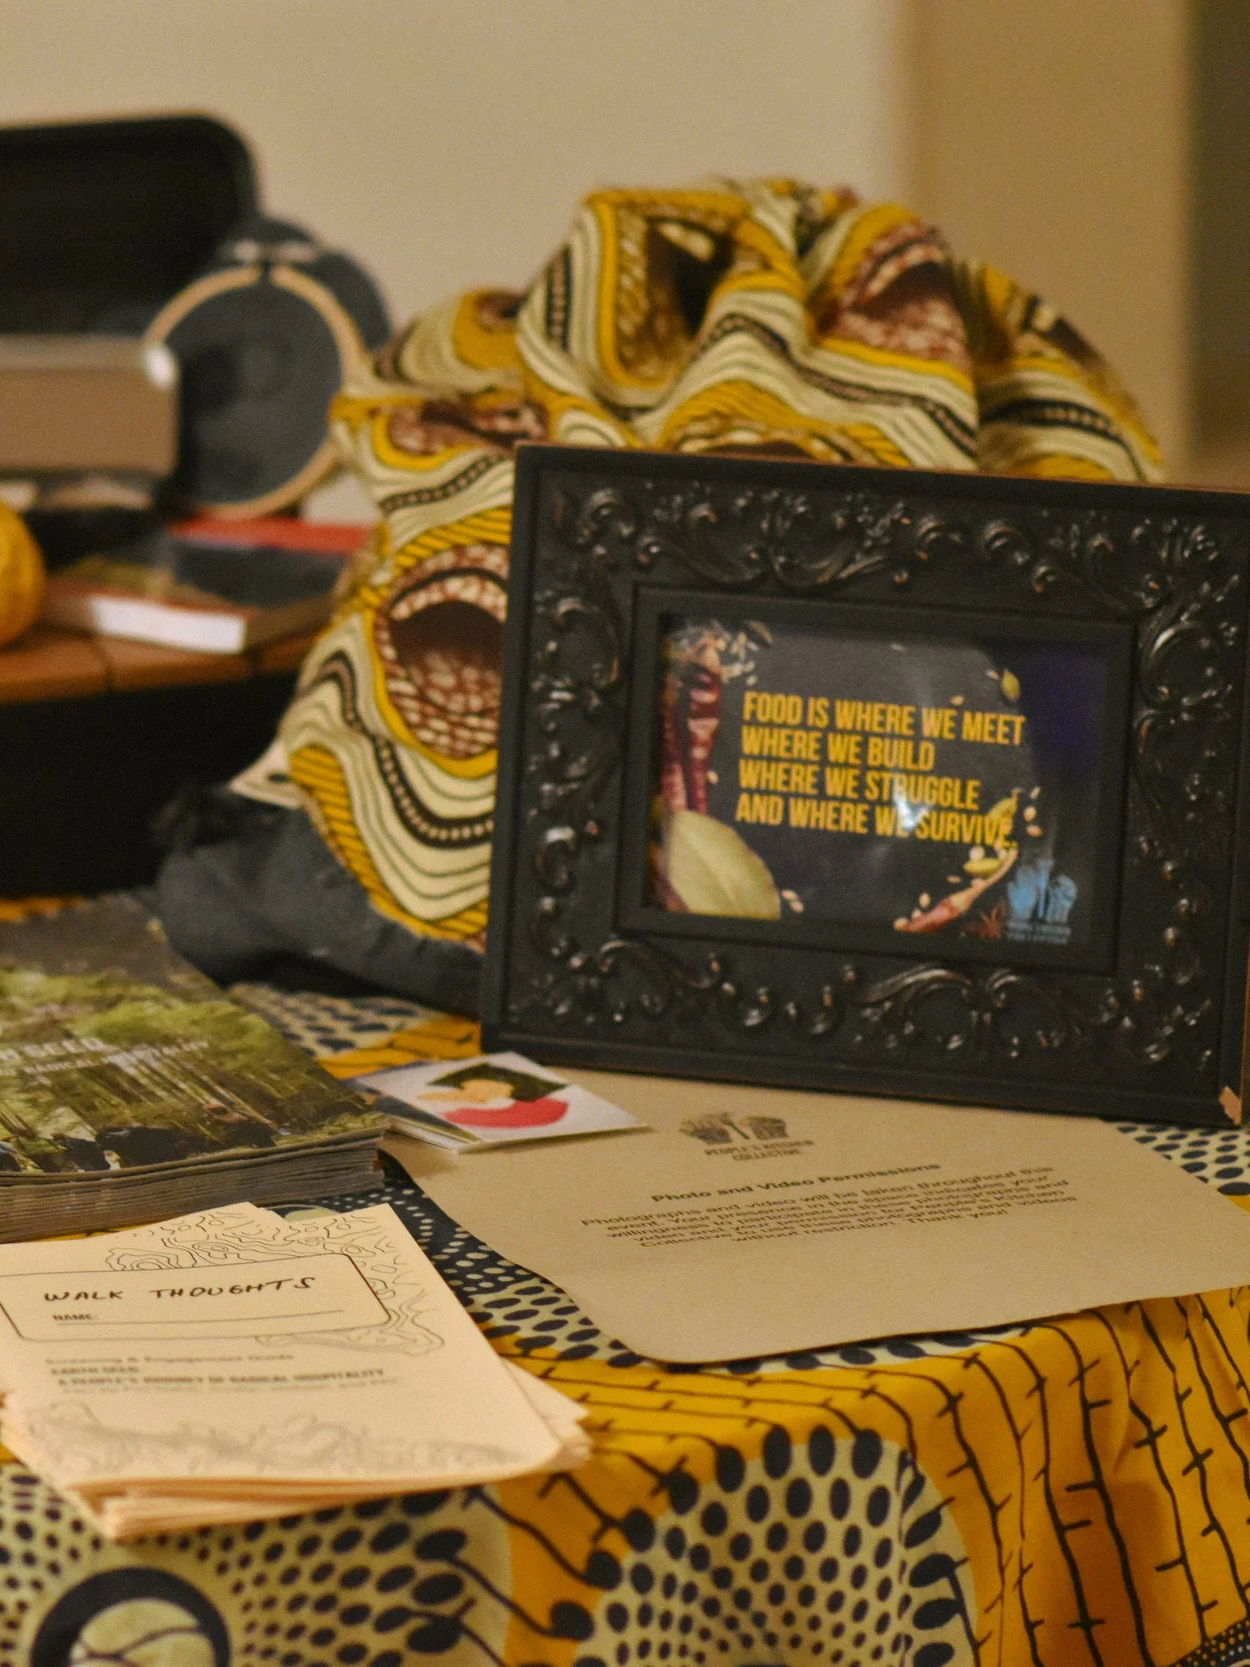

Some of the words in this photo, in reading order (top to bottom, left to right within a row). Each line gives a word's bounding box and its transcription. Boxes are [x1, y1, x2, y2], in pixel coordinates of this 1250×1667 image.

[743, 690, 803, 726] FOOD
[807, 695, 830, 728] IS
[835, 699, 916, 737] WHERE
[921, 706, 958, 741] WE
[962, 710, 1026, 745] MEET
[741, 724, 823, 761] WHERE
[827, 732, 862, 765] WE
[867, 736, 935, 771] BUILD
[739, 759, 819, 795] WHERE
[824, 766, 860, 800] WE
[865, 770, 981, 810] STRUGGLE
[735, 792, 784, 826] AND
[788, 796, 870, 834] WHERE
[651, 1191, 712, 1202] Photo
[716, 1185, 754, 1195] and
[756, 1180, 815, 1190] Video
[817, 1163, 941, 1183] Permissions
[44, 1289, 124, 1302] WALK
[149, 1276, 316, 1298] THOUGHTS
